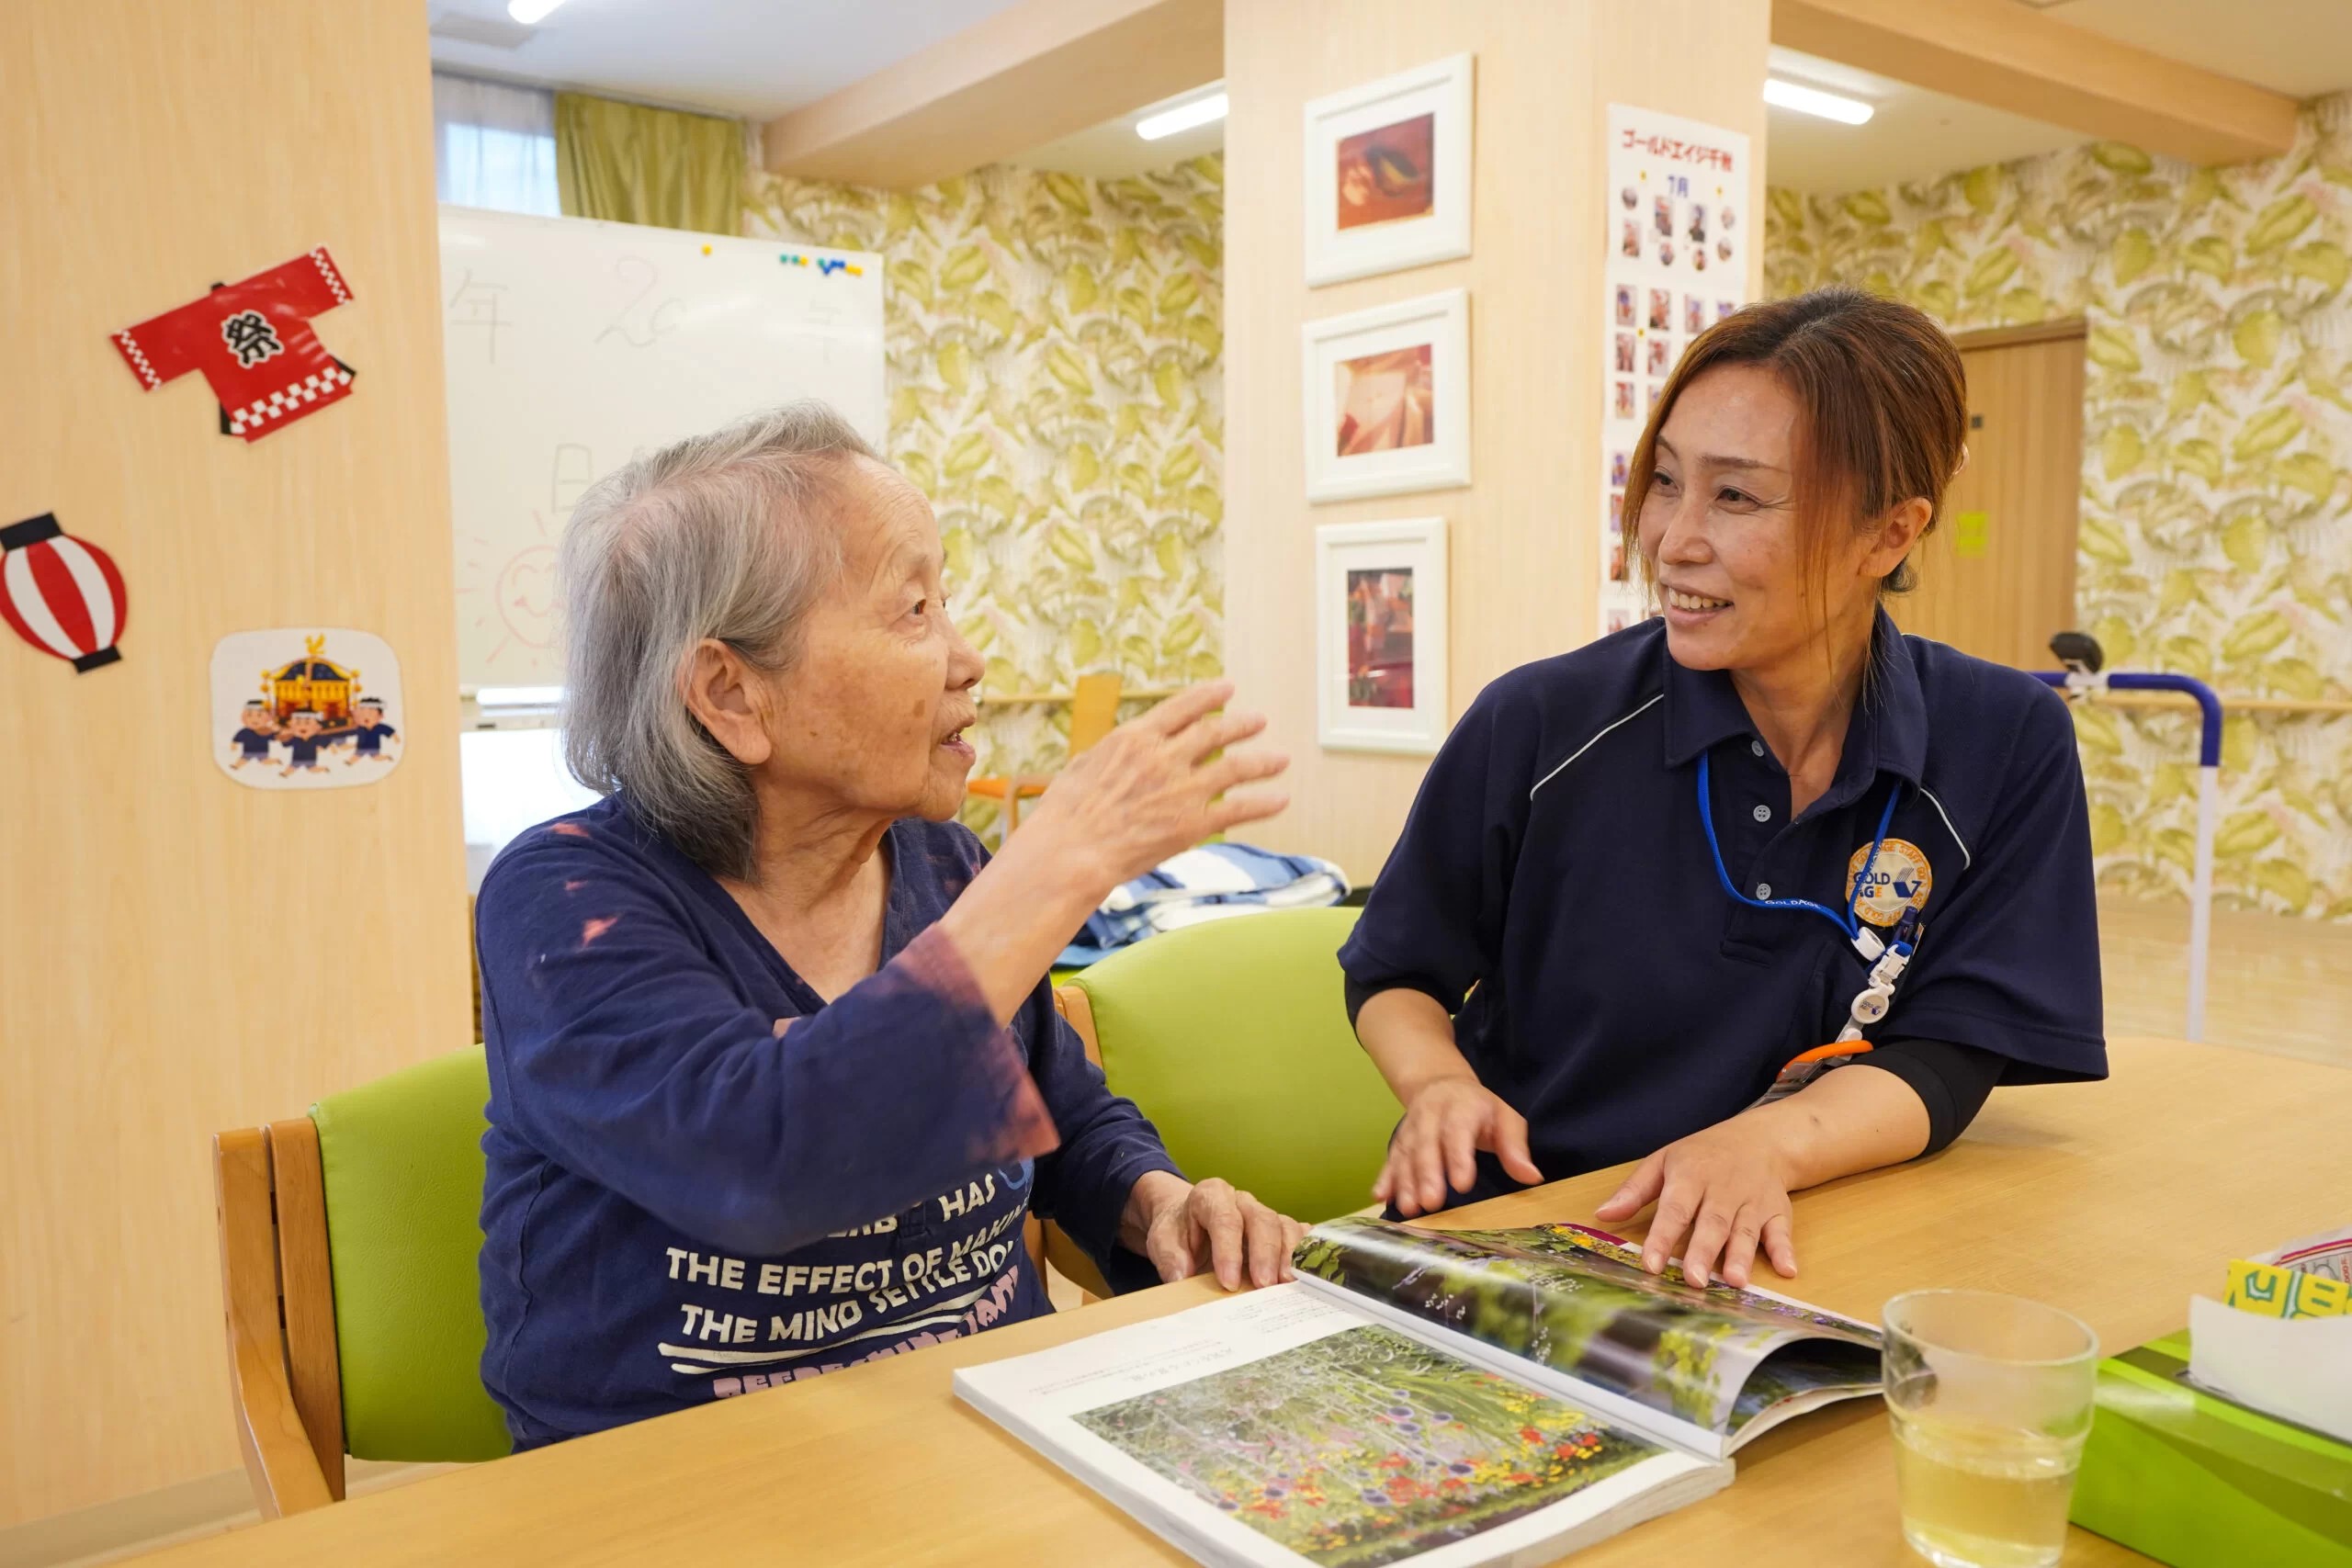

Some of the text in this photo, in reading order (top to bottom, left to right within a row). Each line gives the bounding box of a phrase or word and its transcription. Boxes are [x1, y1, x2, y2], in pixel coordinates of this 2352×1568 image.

[224, 310, 283, 367] 祭
[938, 1173, 995, 1222] HAS
[666, 1247, 745, 1291] THE
[757, 1259, 893, 1296] EFFECT
[902, 1247, 943, 1282] OF
[681, 1303, 758, 1343] THE
[768, 1300, 863, 1341] MIND
